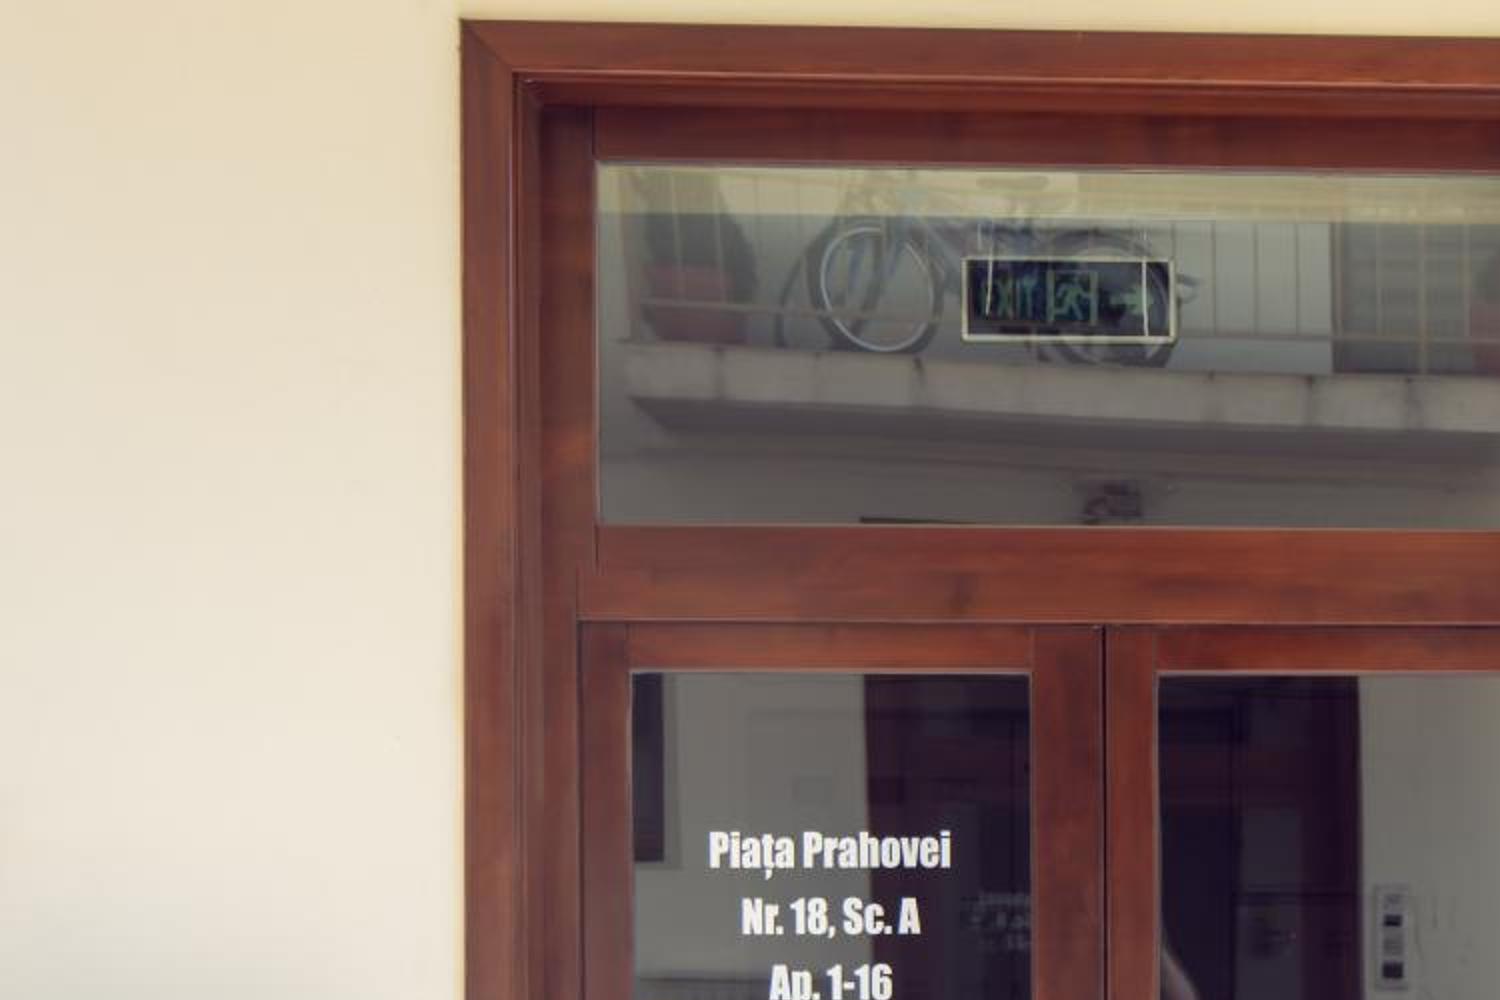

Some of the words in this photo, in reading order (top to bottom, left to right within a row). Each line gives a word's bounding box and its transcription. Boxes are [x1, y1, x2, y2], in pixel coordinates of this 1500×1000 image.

[803, 831, 951, 868] Prahovei
[741, 898, 783, 935] Nr.
[790, 898, 836, 938] 18,
[843, 898, 892, 935] Sc.
[898, 898, 921, 935] A
[827, 965, 893, 1000] 1-16
